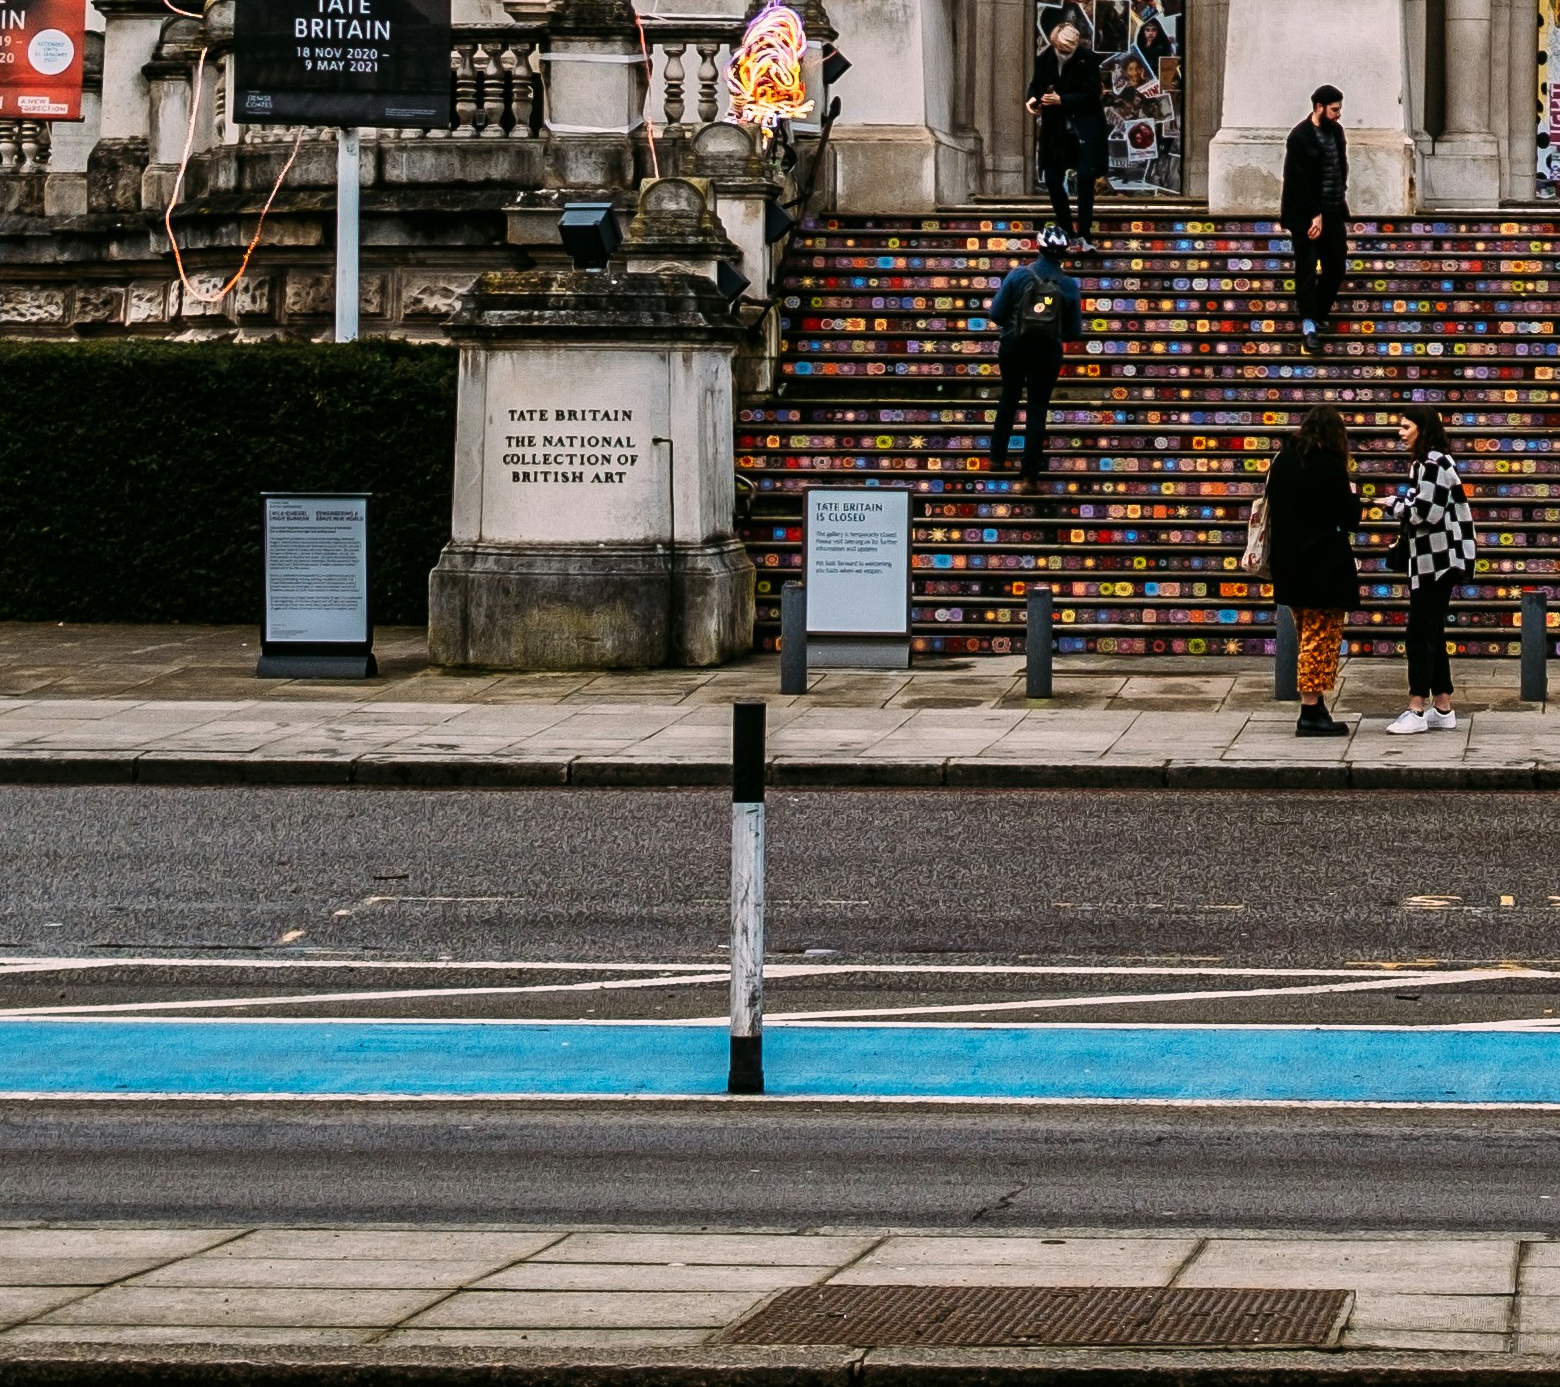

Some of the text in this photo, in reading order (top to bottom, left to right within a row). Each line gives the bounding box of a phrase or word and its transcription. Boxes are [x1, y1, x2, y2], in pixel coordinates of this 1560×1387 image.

[295, 18, 390, 41] BRITAIN
[296, 46, 310, 58] 18
[315, 48, 342, 58] NOV
[346, 48, 378, 59] 2020
[305, 60, 378, 72] 9 MAY 2021
[509, 410, 632, 422] TATE BRITAIN
[506, 436, 636, 448] THE NATIONAL
[503, 454, 638, 467] COLLECTION OF
[512, 471, 627, 484] BRITISH ART
[816, 502, 883, 512] TATE BRITAIN
[816, 513, 866, 522] IS CLOSED
